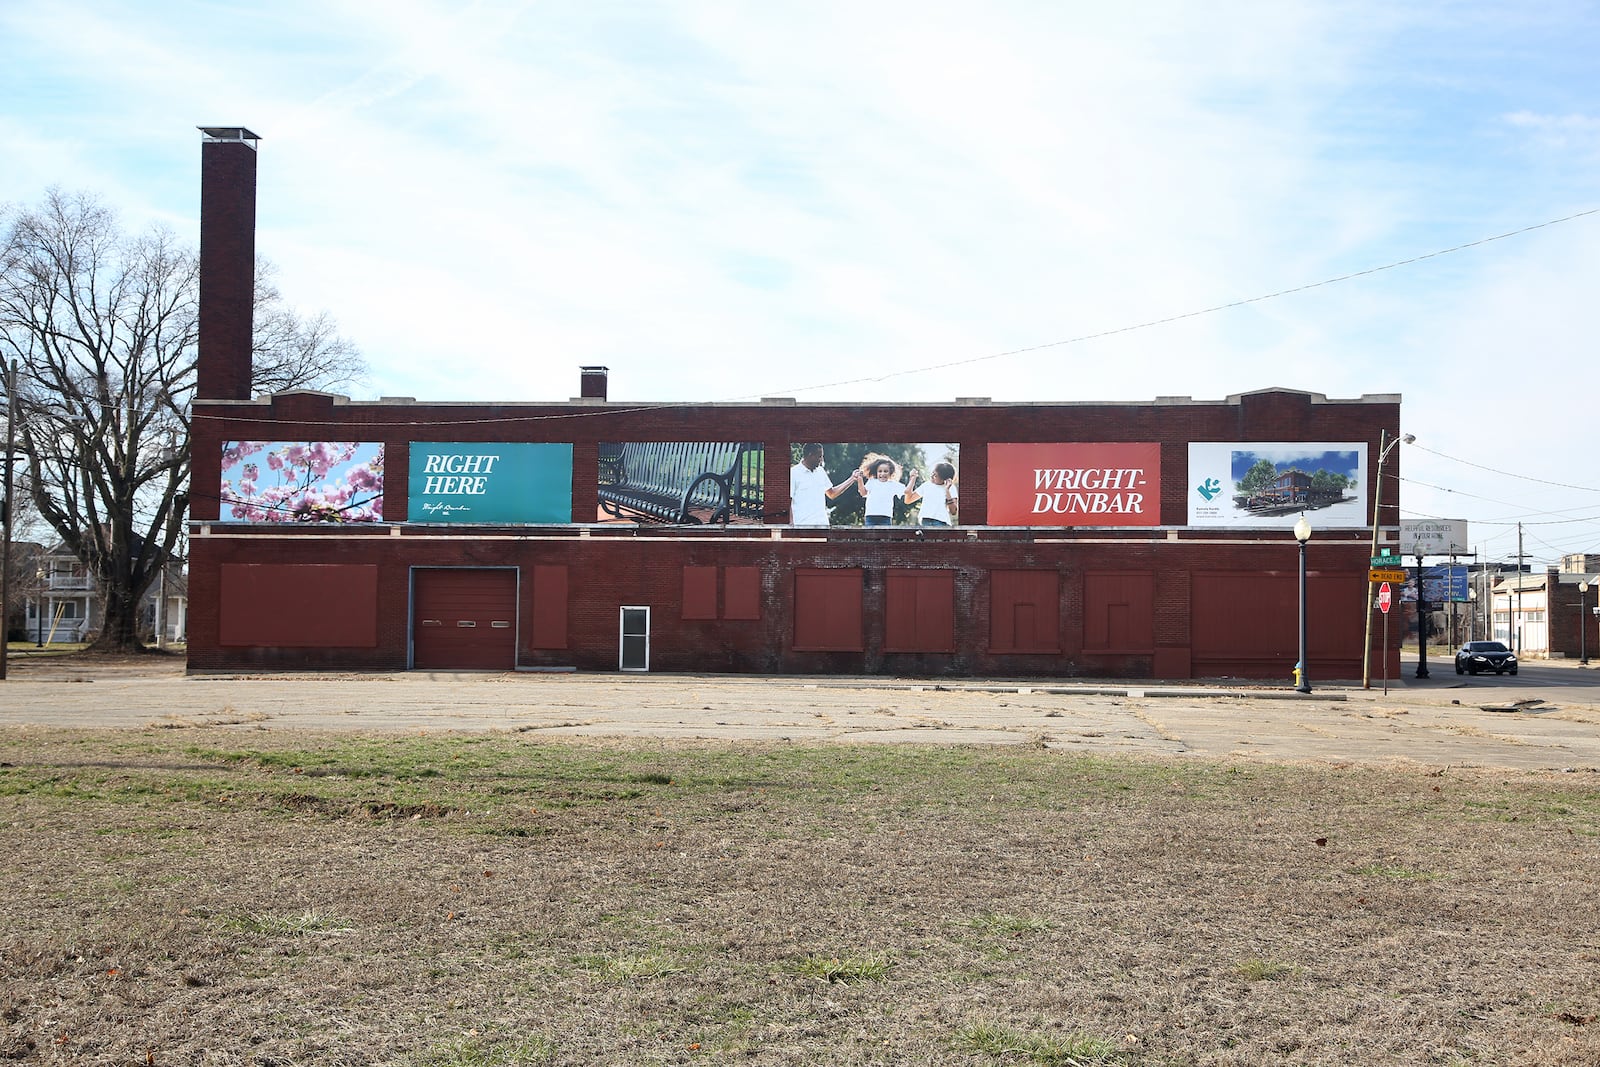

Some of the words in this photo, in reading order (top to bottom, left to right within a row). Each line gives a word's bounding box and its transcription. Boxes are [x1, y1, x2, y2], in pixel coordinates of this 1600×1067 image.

[423, 454, 500, 474] RIGHT
[422, 475, 488, 495] HERE
[1033, 468, 1147, 490] WRIGHT-
[1031, 492, 1144, 514] DUNBAR
[1371, 557, 1393, 565] HORACE
[1379, 592, 1391, 603] STOP
